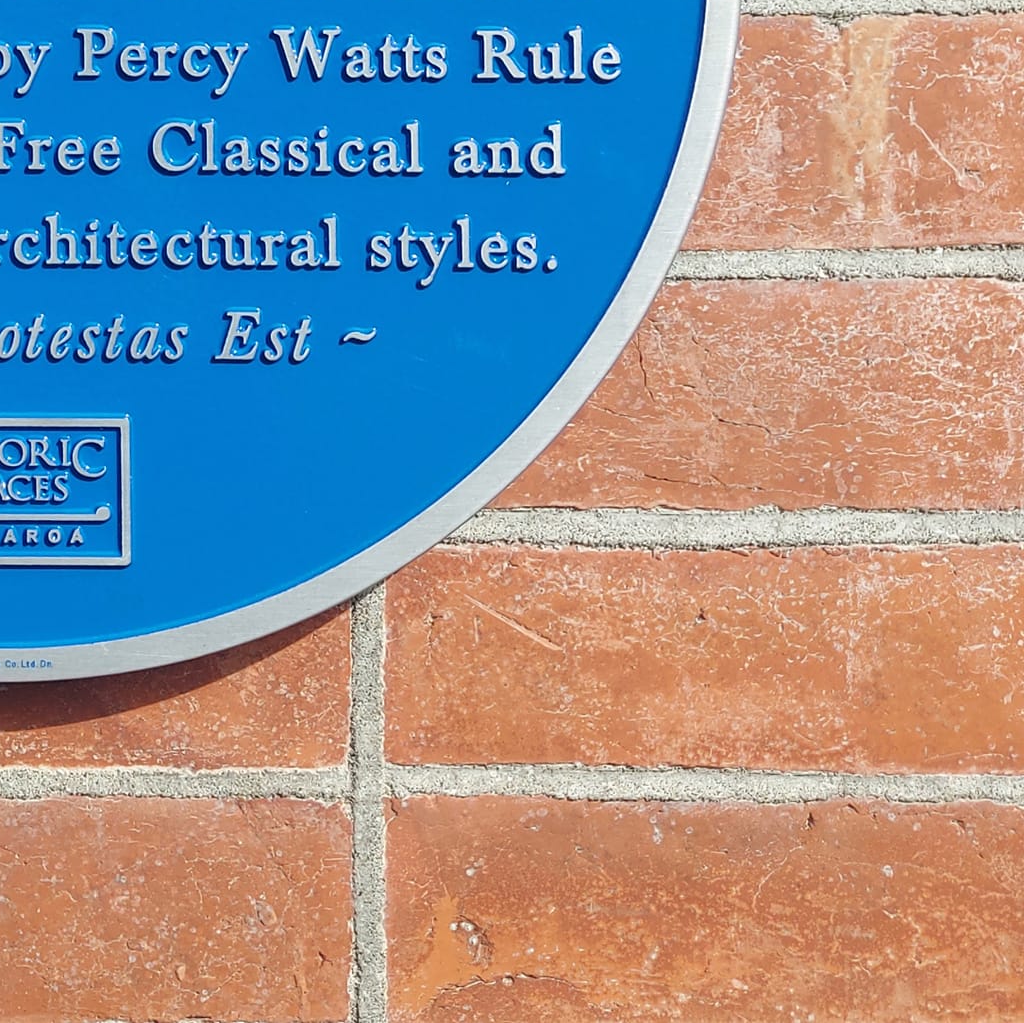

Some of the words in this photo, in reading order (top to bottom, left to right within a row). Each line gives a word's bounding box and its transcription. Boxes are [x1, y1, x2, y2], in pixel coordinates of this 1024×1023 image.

[77, 28, 249, 97] Percy
[273, 26, 447, 81] Watts
[476, 26, 621, 82] Rule
[152, 119, 424, 175] Classical
[453, 124, 565, 176] and
[370, 218, 559, 288] styles.
[214, 308, 312, 363] Est
